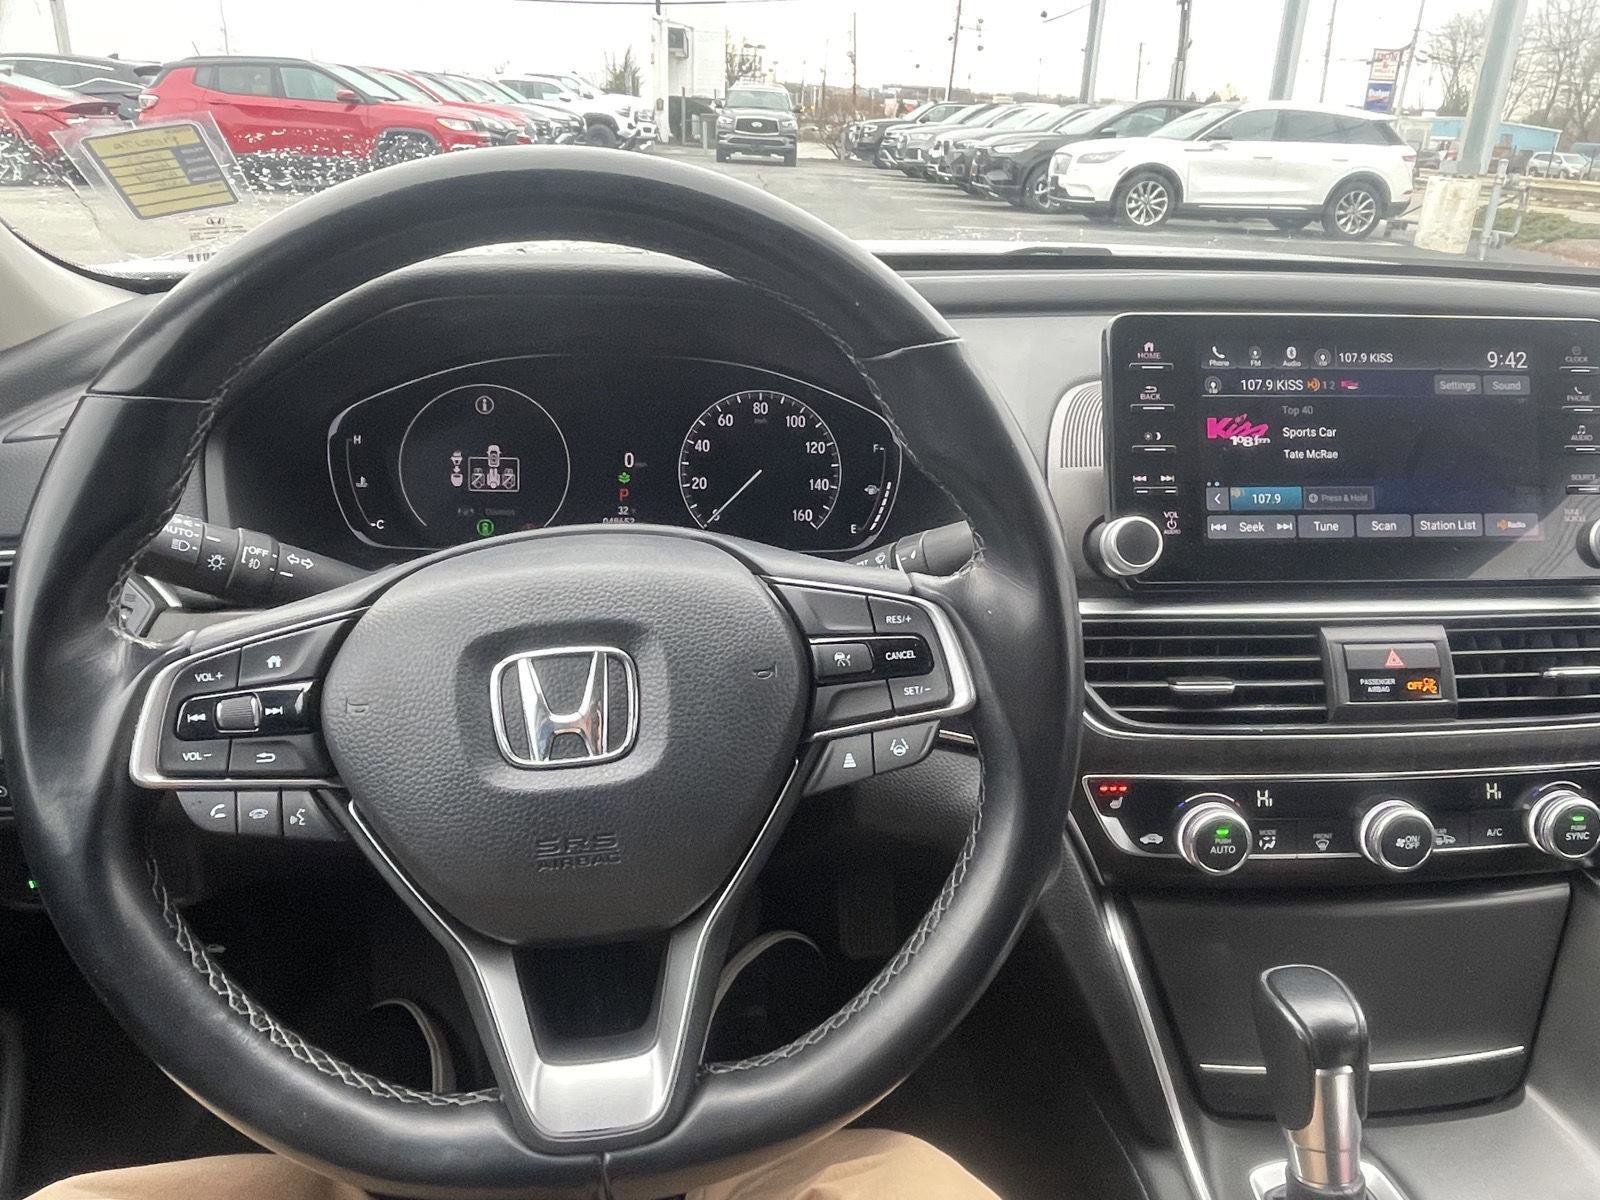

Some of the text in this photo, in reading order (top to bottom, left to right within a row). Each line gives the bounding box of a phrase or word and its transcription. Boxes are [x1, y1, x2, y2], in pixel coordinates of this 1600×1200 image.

[1137, 352, 1161, 360] HOME
[1339, 352, 1394, 363] 107.9 KISS
[1487, 351, 1528, 369] 9:42
[1240, 379, 1273, 391] 107.9
[1276, 379, 1304, 391] KISS
[1439, 381, 1476, 392] Settings
[1492, 381, 1521, 391] Sound
[1139, 393, 1161, 401] BACK
[752, 402, 768, 415] 80
[1282, 406, 1313, 416] Top 40
[717, 414, 734, 427] 60
[785, 415, 806, 429] 100
[1282, 427, 1337, 440] Sports Car
[353, 435, 362, 444] H
[694, 439, 711, 453] 40
[805, 441, 826, 455] 120
[624, 452, 635, 468] 0
[1283, 450, 1339, 460] Tate McRae
[691, 476, 708, 490] 20
[809, 478, 830, 491] 140
[619, 488, 629, 502] P
[1252, 493, 1282, 504] 107.9
[617, 505, 629, 516] 32
[792, 509, 813, 522] 160
[1163, 511, 1179, 519] VOL
[375, 519, 385, 529] C
[850, 523, 857, 534] E
[1239, 522, 1265, 533] Seek
[1313, 522, 1339, 532] Tune
[1371, 520, 1397, 532] Scan
[1420, 520, 1477, 531] Station List
[162, 525, 194, 538] AUTO
[248, 546, 270, 557] OFF
[885, 615, 912, 625] RES/+
[885, 650, 916, 661] CANCEL
[1360, 678, 1396, 686] PASSENGER
[1406, 680, 1423, 691] OFF
[1486, 828, 1503, 837] A/C
[1565, 832, 1590, 842] SYNC
[1210, 845, 1236, 855] AUTO
[1405, 842, 1420, 850] OFF
